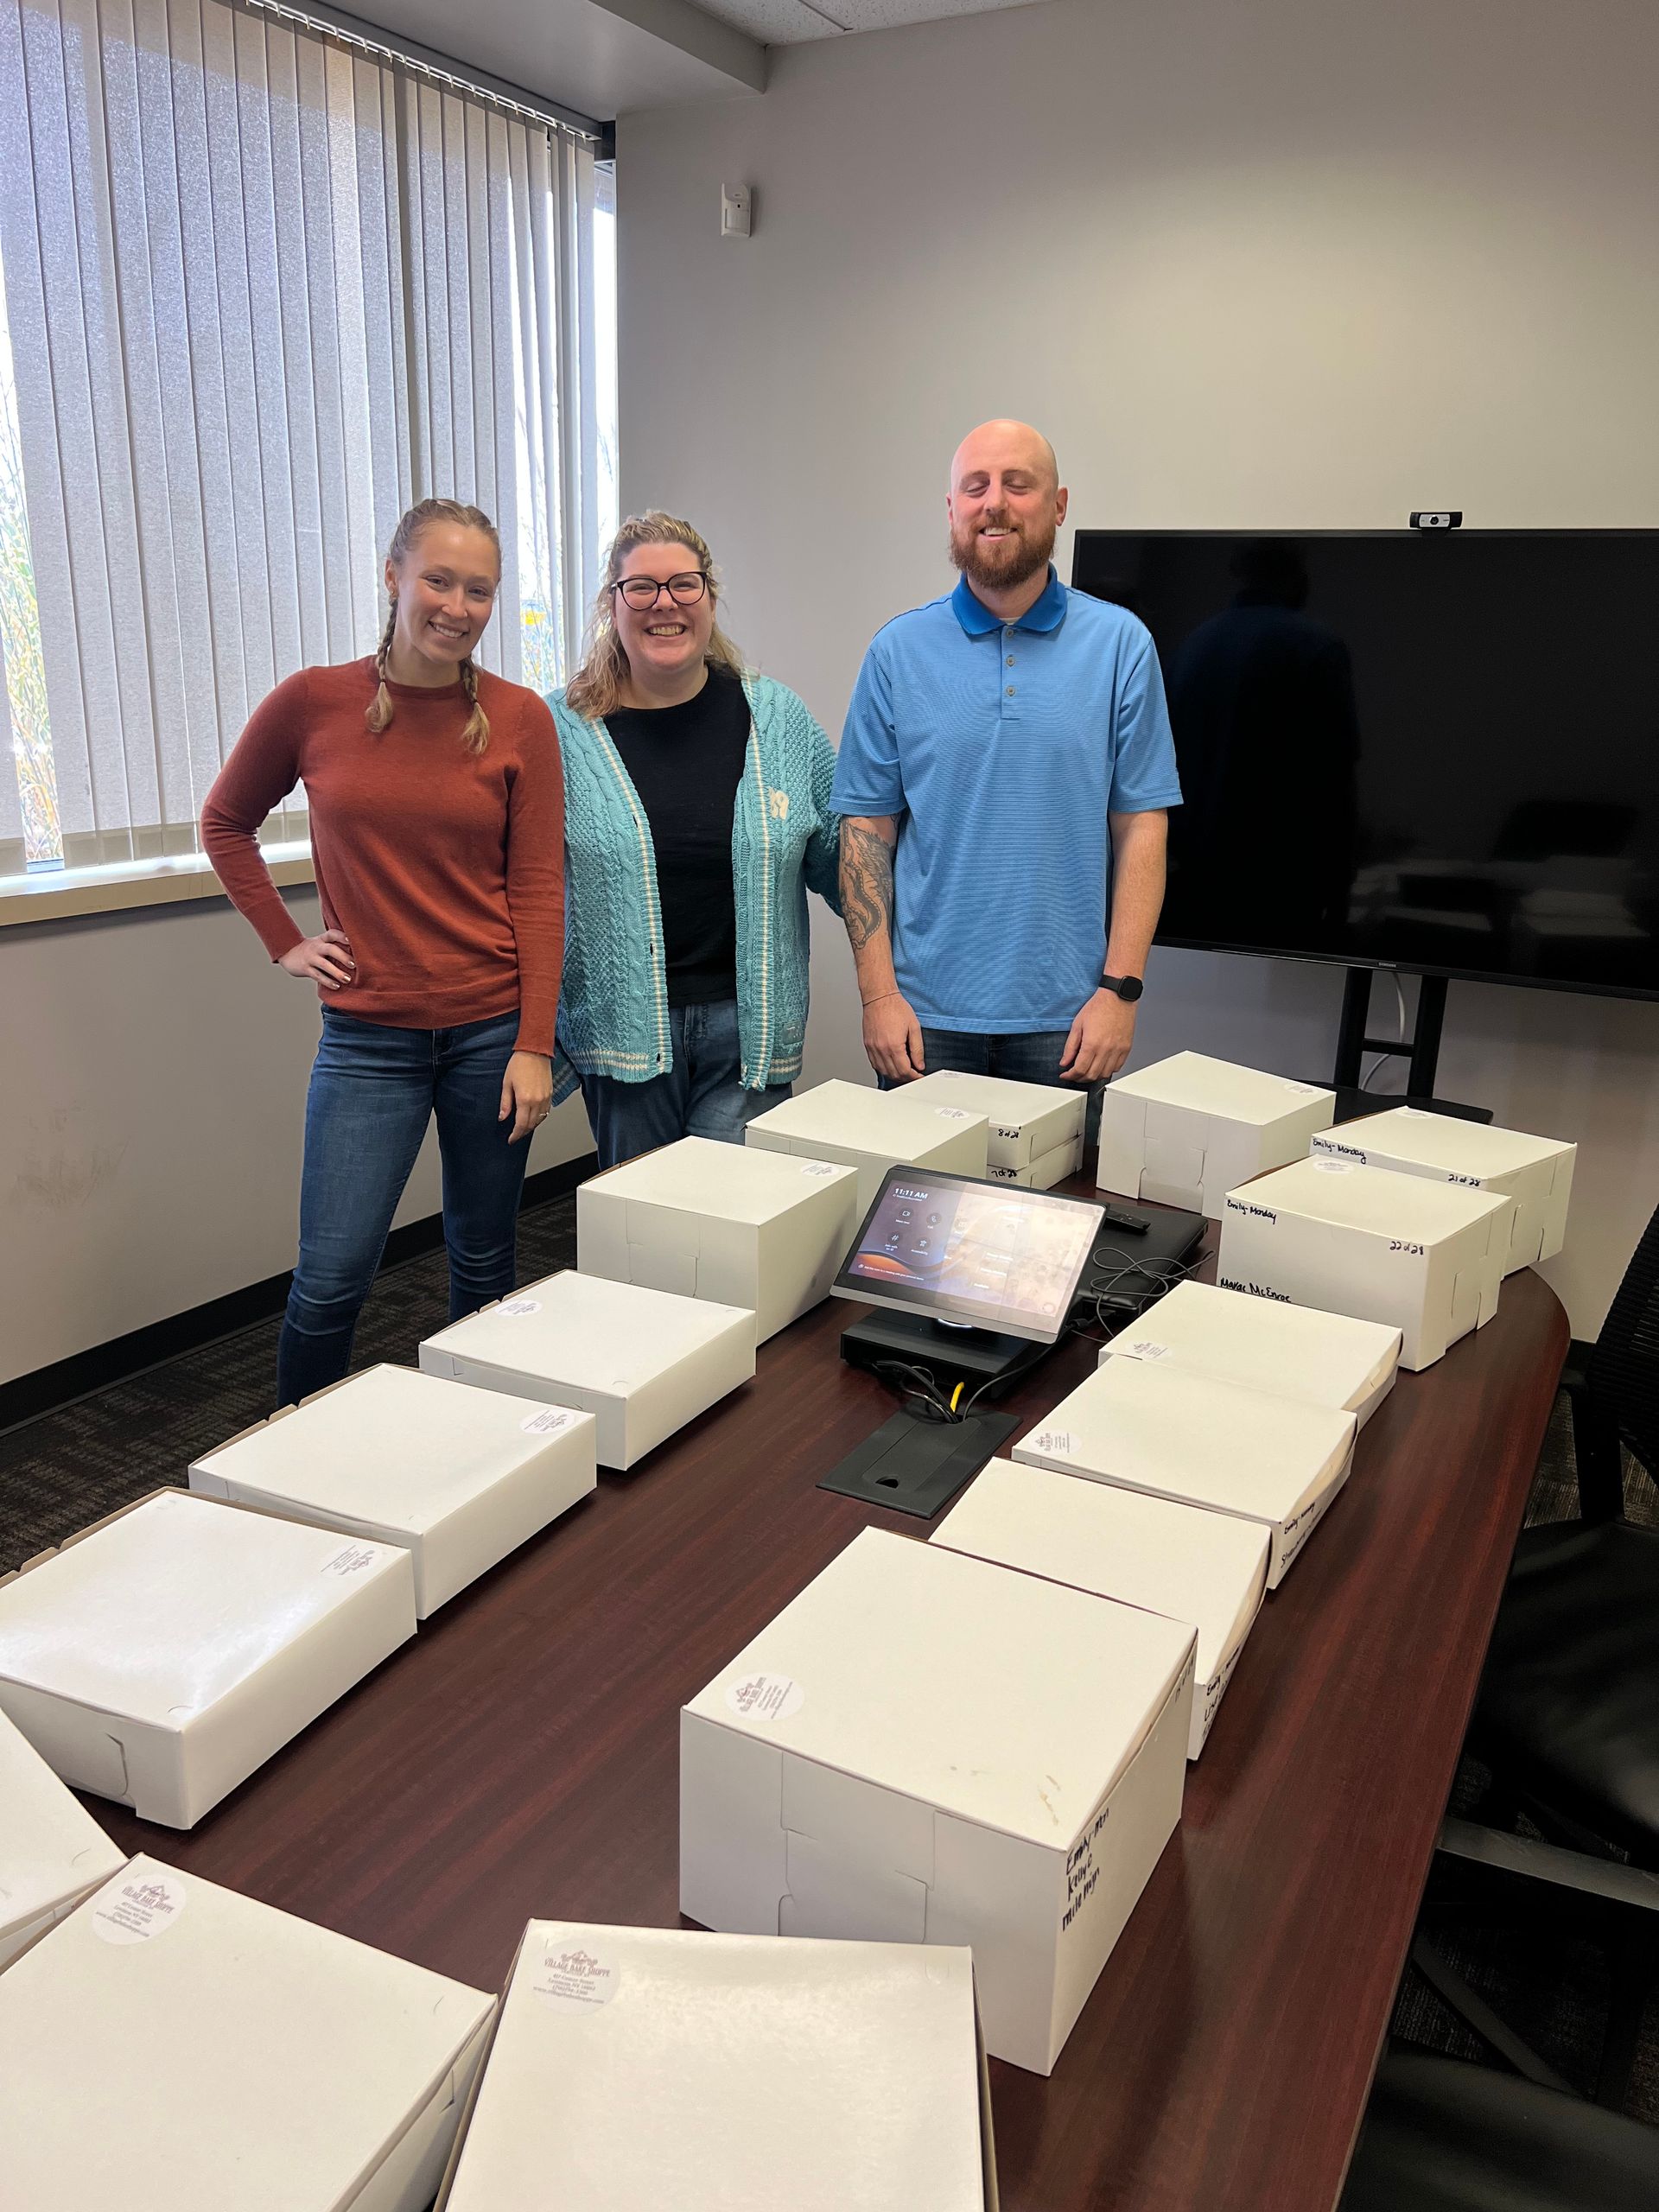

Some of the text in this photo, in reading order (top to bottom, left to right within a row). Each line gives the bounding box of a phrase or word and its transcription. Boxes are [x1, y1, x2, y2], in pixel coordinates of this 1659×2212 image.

[1338, 1144, 1367, 1165] Monday
[1448, 1173, 1459, 1182] 21
[1469, 1178, 1481, 1187] 28
[894, 1188, 914, 1197] 11:11
[1249, 1206, 1277, 1225] Monday
[1389, 1241, 1424, 1255] 22 of 28
